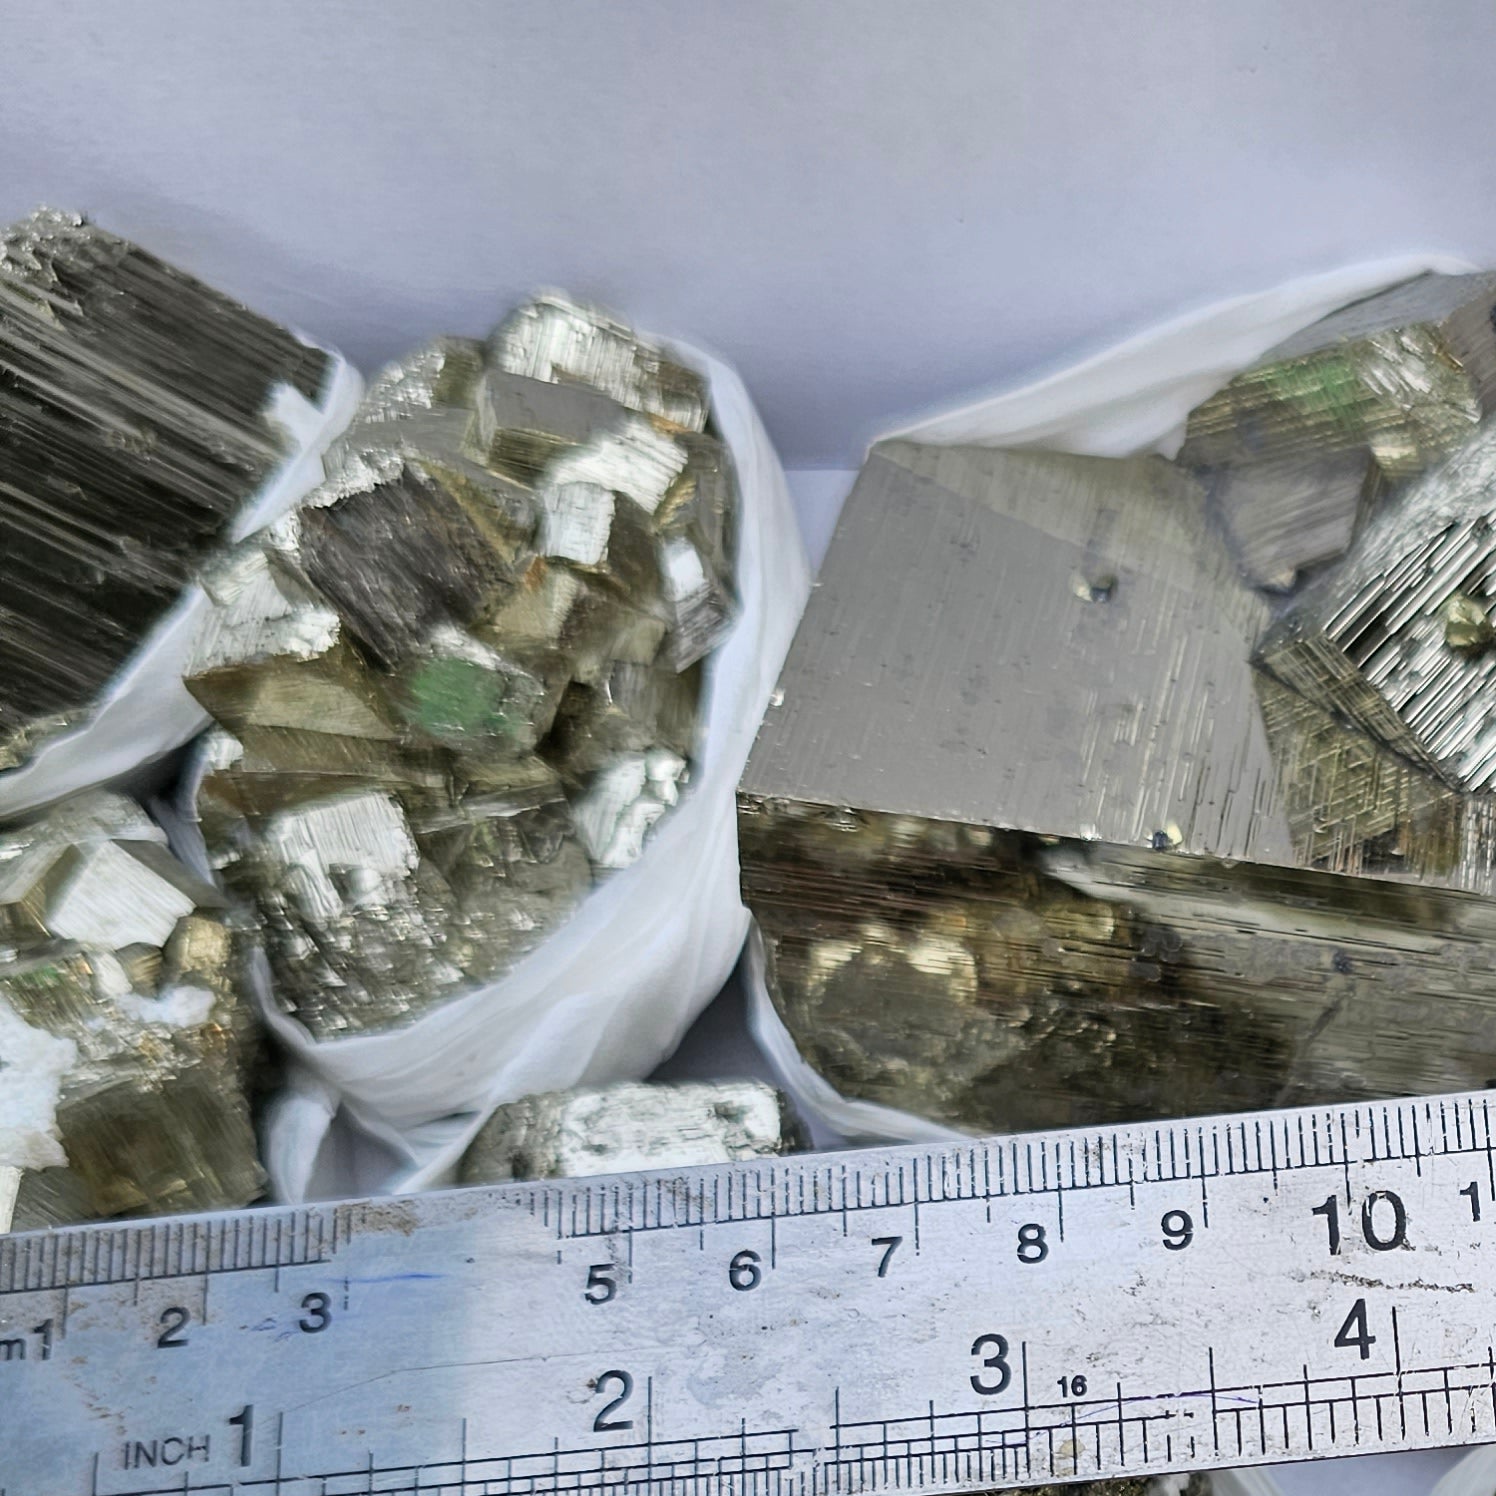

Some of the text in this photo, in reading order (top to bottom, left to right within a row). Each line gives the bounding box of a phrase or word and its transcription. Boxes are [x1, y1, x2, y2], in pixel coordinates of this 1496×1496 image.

[33, 1318, 54, 1361] 1
[157, 1307, 189, 1348] 2
[300, 1292, 332, 1333] 3
[584, 1263, 617, 1305] 5
[729, 1250, 762, 1291] 6
[871, 1236, 901, 1278] 7
[1017, 1223, 1048, 1264] 8
[1161, 1209, 1193, 1251] 9
[1312, 1190, 1407, 1256] 10
[124, 1434, 211, 1470] INCH
[229, 1404, 254, 1467] 1
[593, 1370, 633, 1433] 2
[970, 1333, 1011, 1395] 3
[1334, 1299, 1376, 1360] 4
[1057, 1373, 1088, 1398] 16
